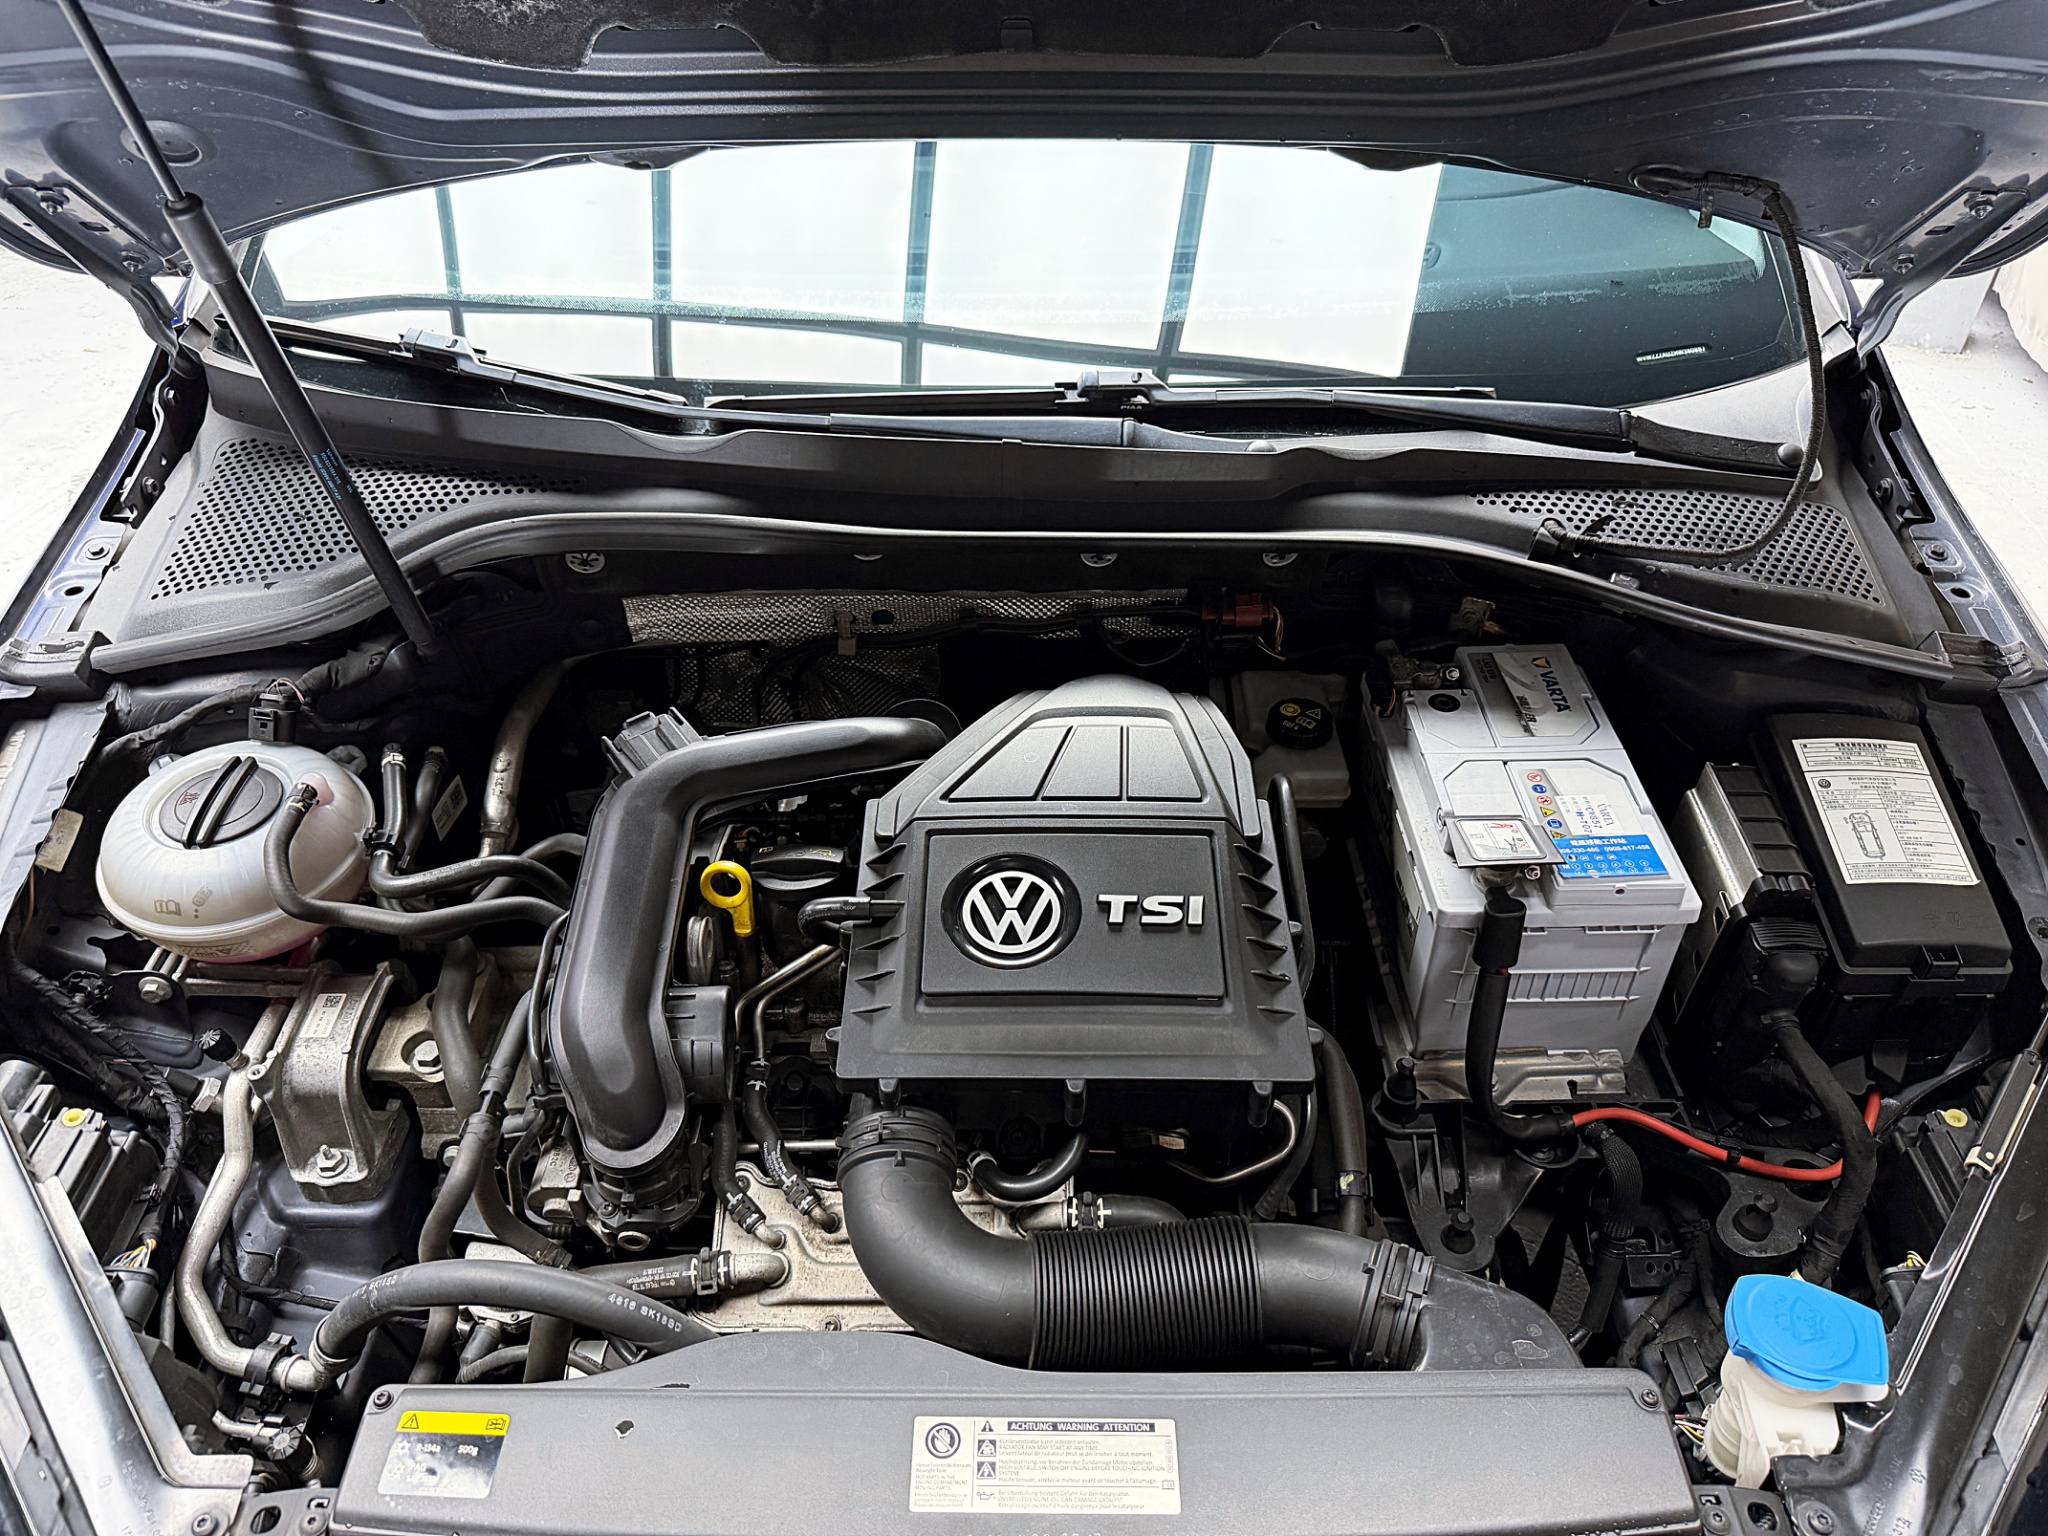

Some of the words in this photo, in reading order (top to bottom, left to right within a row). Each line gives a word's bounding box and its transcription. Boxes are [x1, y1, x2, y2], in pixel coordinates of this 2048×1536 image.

[1540, 670, 1571, 712] VARTA
[962, 871, 1060, 954] VW
[1098, 894, 1204, 926] TSI
[1103, 1423, 1150, 1431] ATTENTION
